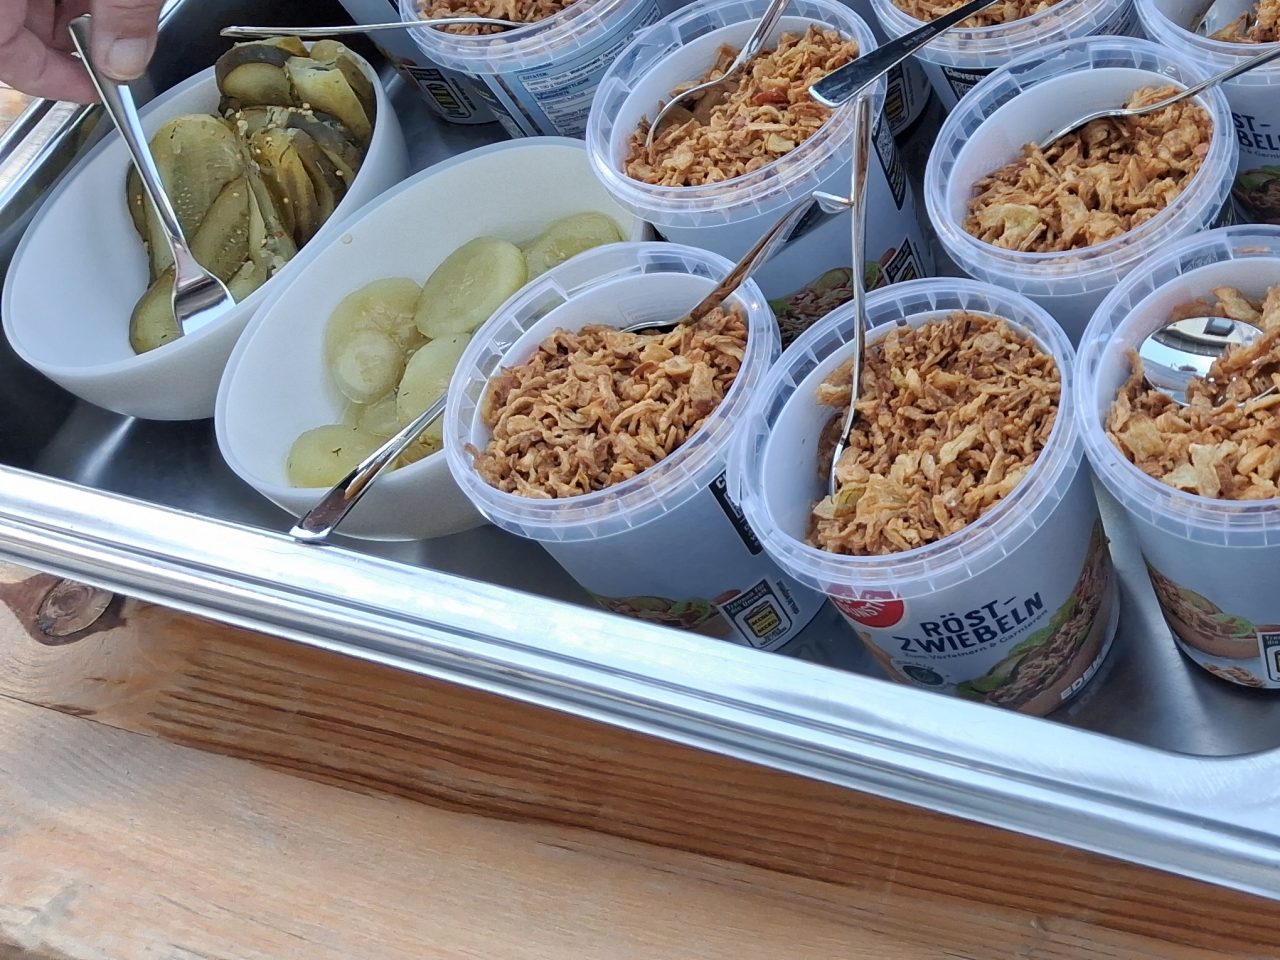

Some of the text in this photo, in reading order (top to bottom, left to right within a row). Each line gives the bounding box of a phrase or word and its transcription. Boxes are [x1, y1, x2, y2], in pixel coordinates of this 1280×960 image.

[1232, 111, 1271, 132] ST-
[892, 591, 1044, 654] ZWIEBELN
[919, 595, 1017, 638] RÖST-
[999, 609, 1049, 643] Garnieren
